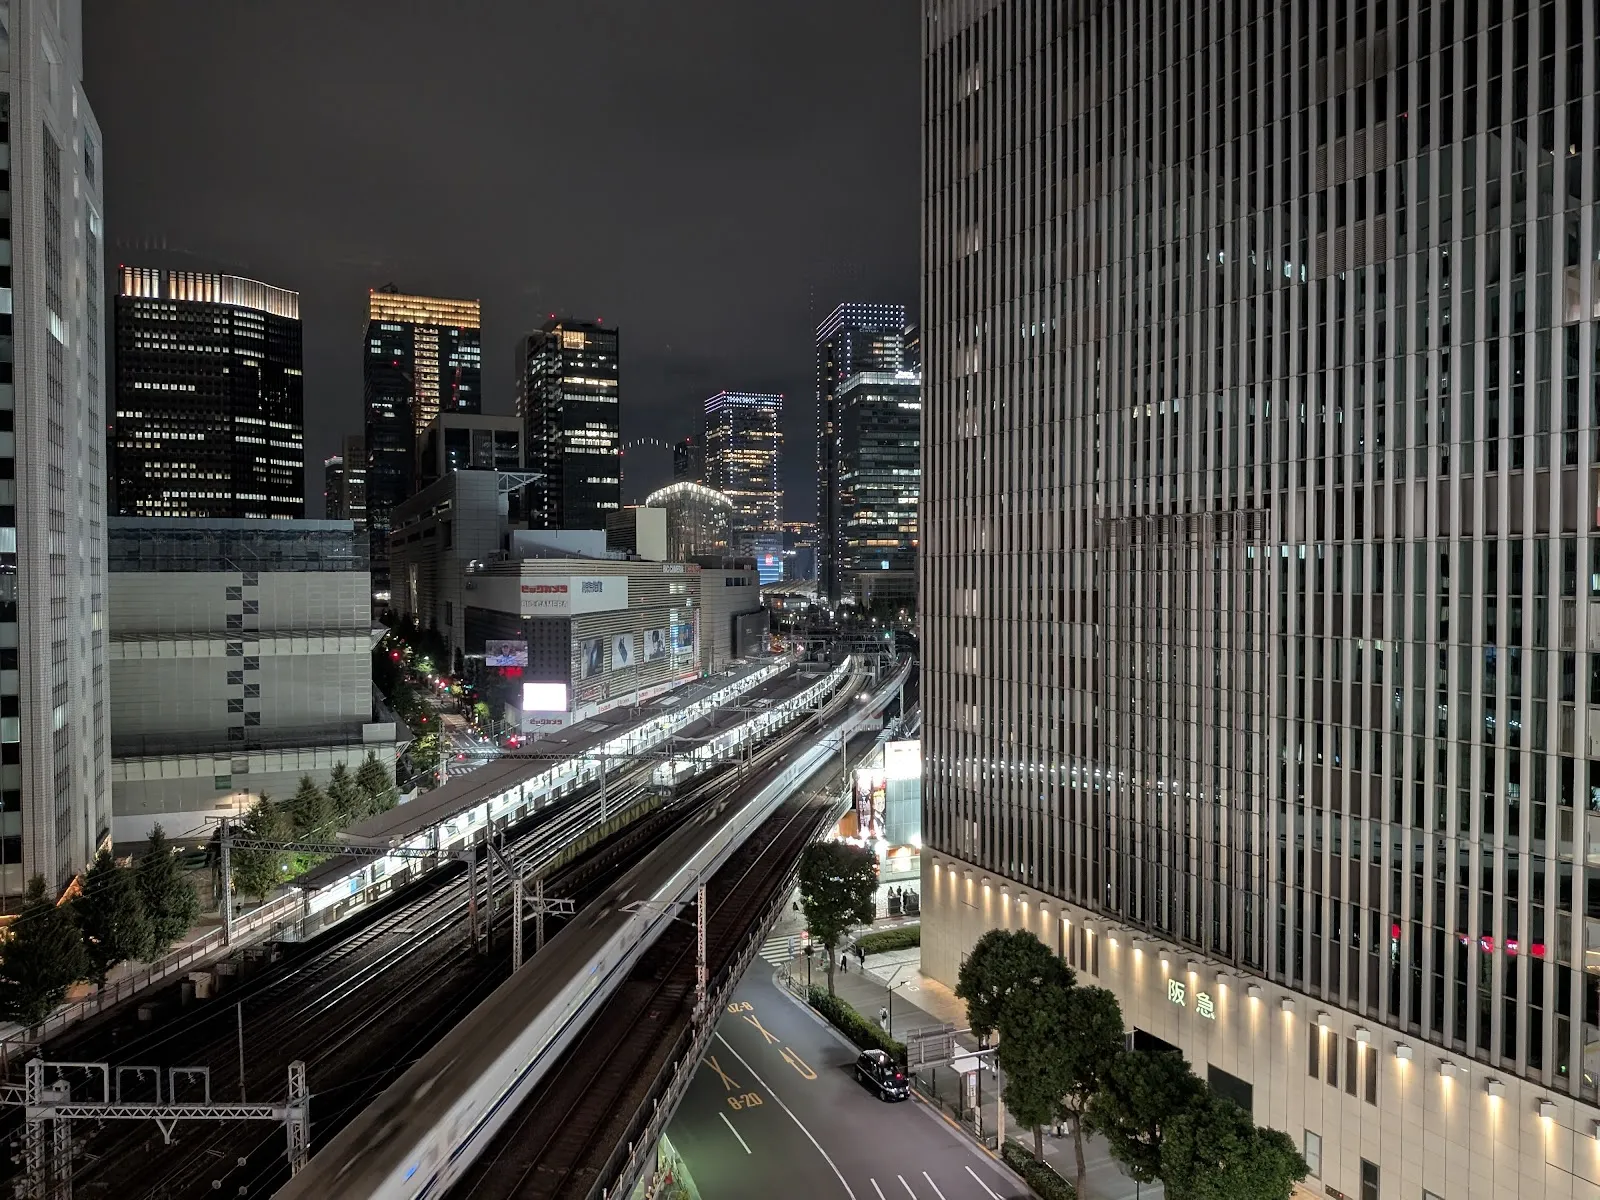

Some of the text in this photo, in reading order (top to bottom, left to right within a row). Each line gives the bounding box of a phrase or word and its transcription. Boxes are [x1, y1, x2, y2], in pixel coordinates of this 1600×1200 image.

[521, 584, 568, 594] ビックカメラ
[535, 599, 568, 608] CAMERA
[1168, 978, 1216, 1020] 阪急
[727, 1092, 763, 1110] 8-20
